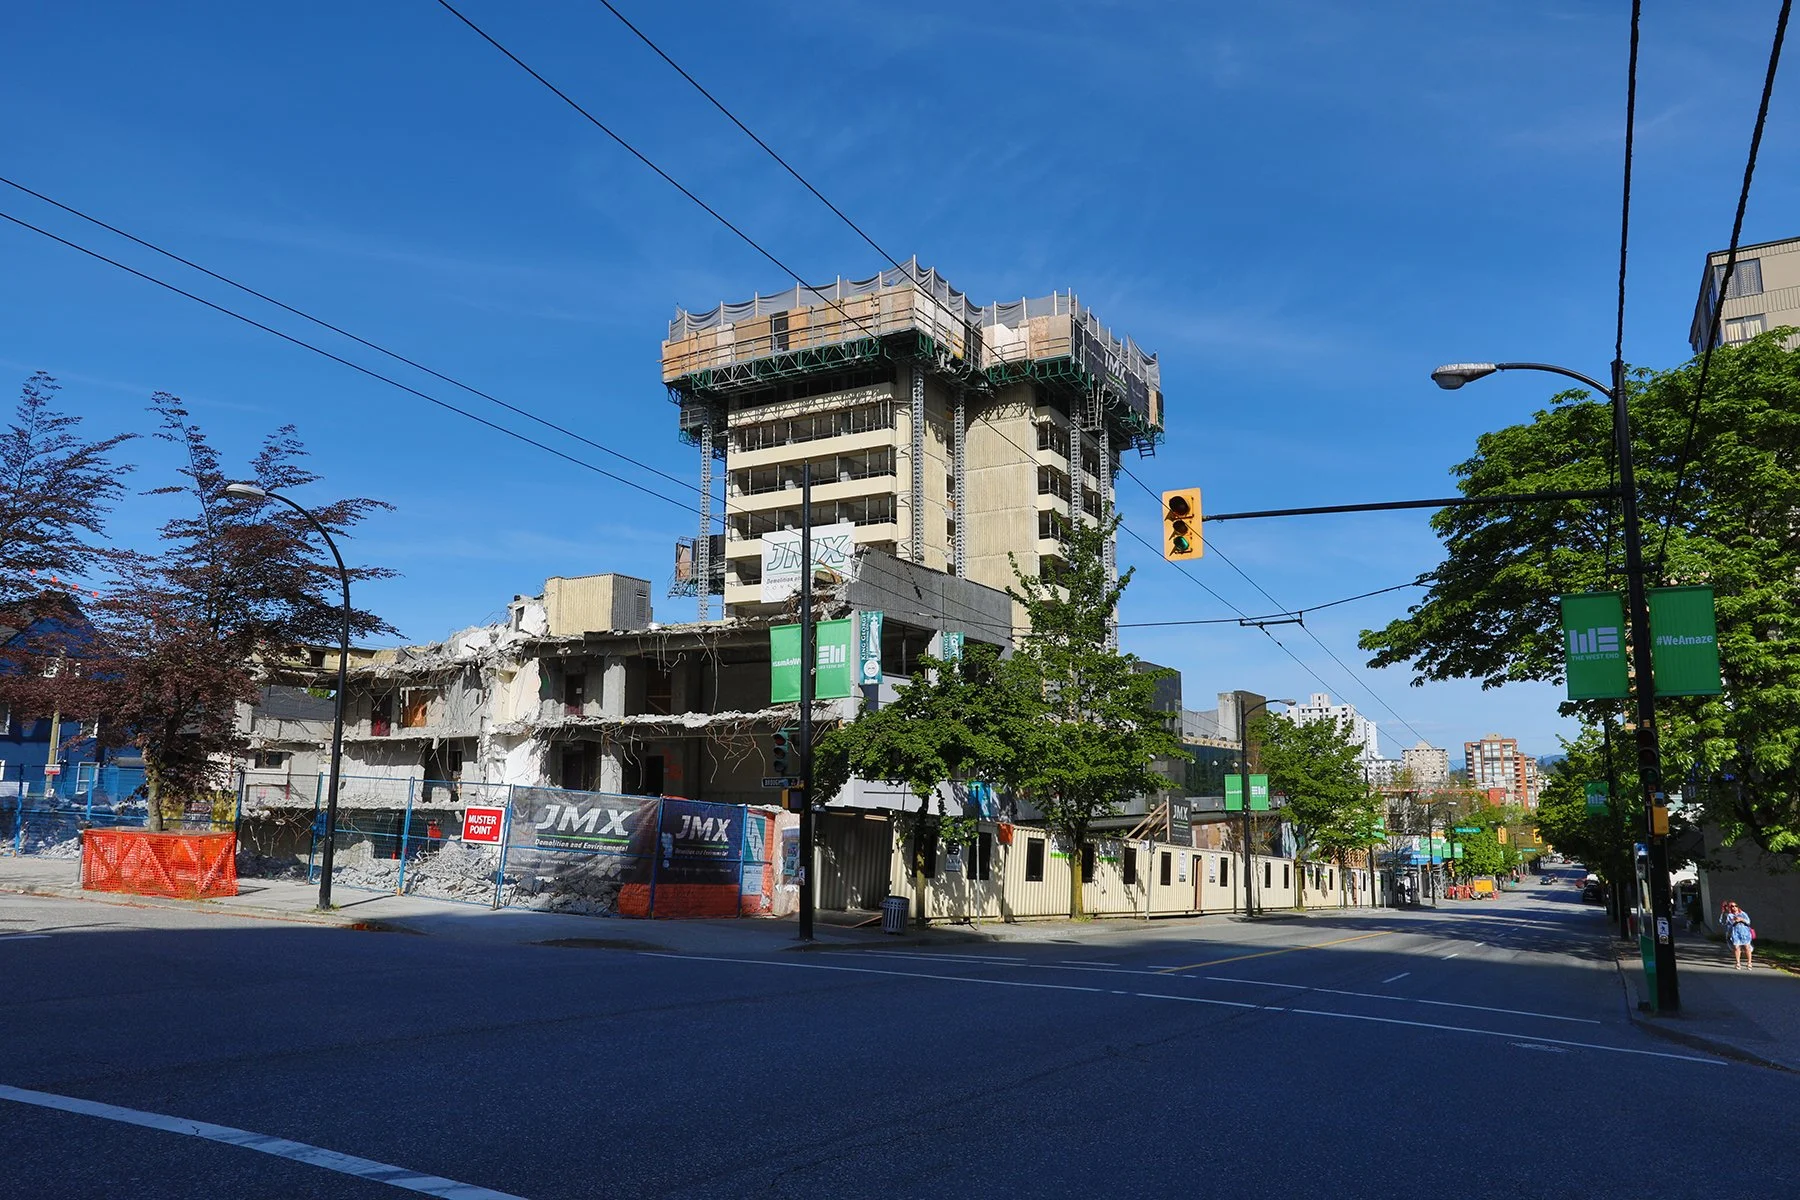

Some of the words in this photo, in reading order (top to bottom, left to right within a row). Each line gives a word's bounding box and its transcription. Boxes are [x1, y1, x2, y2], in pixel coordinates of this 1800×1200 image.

[766, 535, 849, 571] JMX
[1656, 634, 1713, 646] #WeAmaze
[468, 814, 497, 825] MUSTER
[1173, 805, 1188, 820] JMX
[535, 804, 633, 836] JMX
[469, 825, 492, 835] POINT
[675, 814, 731, 842] JMX
[534, 838, 569, 848] Demolition
[570, 841, 582, 849] and
[583, 842, 629, 852] Environmental
